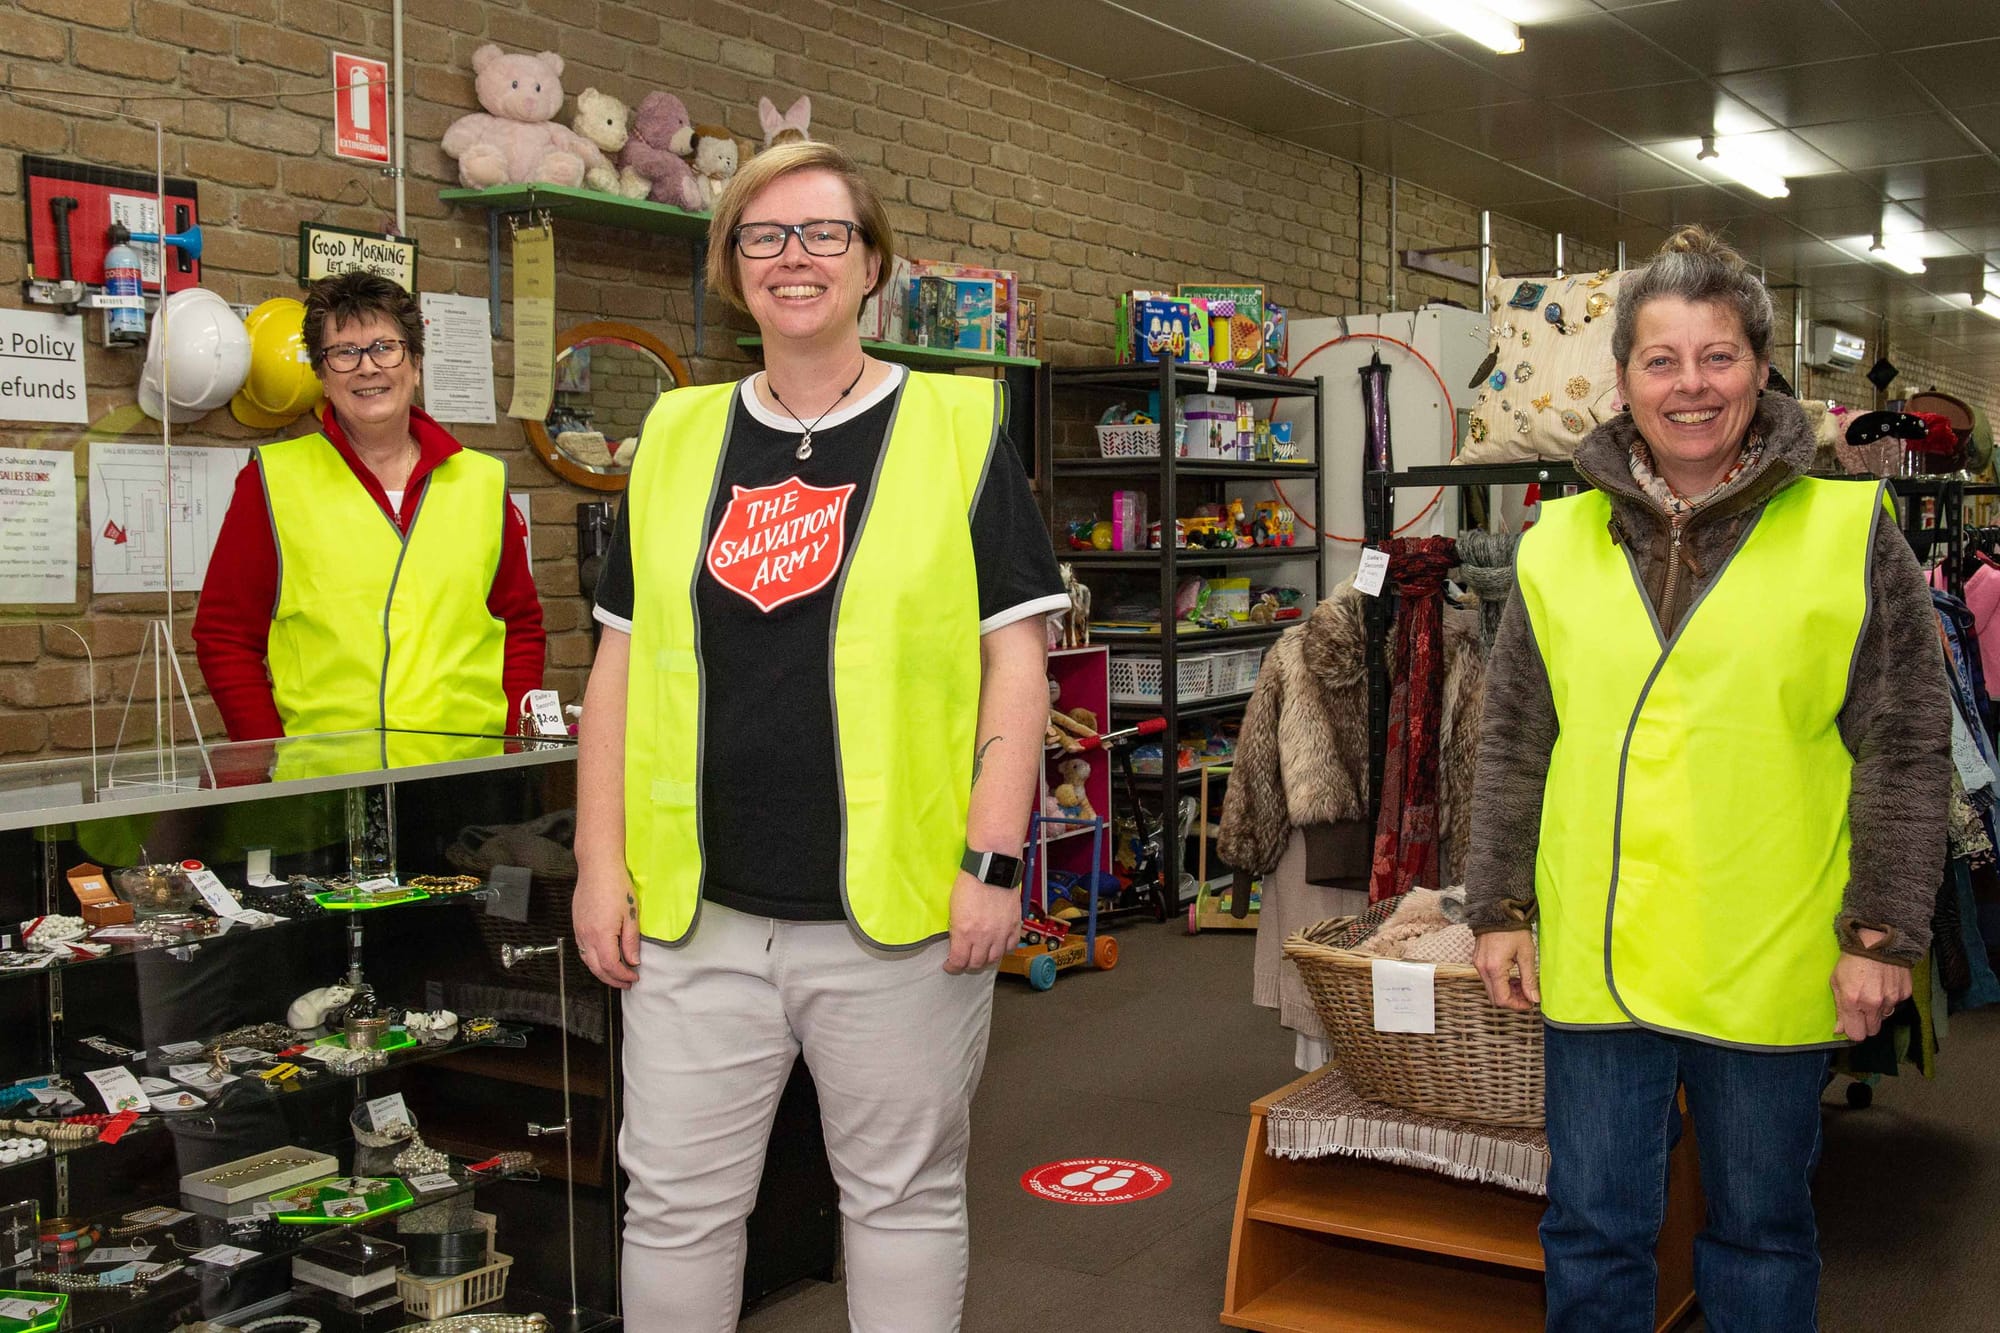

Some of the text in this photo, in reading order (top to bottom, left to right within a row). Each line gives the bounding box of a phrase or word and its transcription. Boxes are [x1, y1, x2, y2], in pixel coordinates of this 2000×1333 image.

[311, 233, 346, 256] GOOD
[326, 258, 343, 272] LET
[12, 333, 75, 360] Policy
[0, 375, 76, 400] efunds
[5, 457, 37, 465] Salvation
[39, 459, 57, 468] Army
[0, 488, 25, 496] elivery
[746, 490, 800, 529] THE
[714, 496, 841, 568] SALVATION
[750, 533, 830, 592] ARMY
[1060, 1159, 1095, 1167] HERE
[1098, 1159, 1137, 1168] STAND
[1028, 1178, 1134, 1202] PROTECT YOURSELF
[1048, 1183, 1094, 1197] OTHERS
